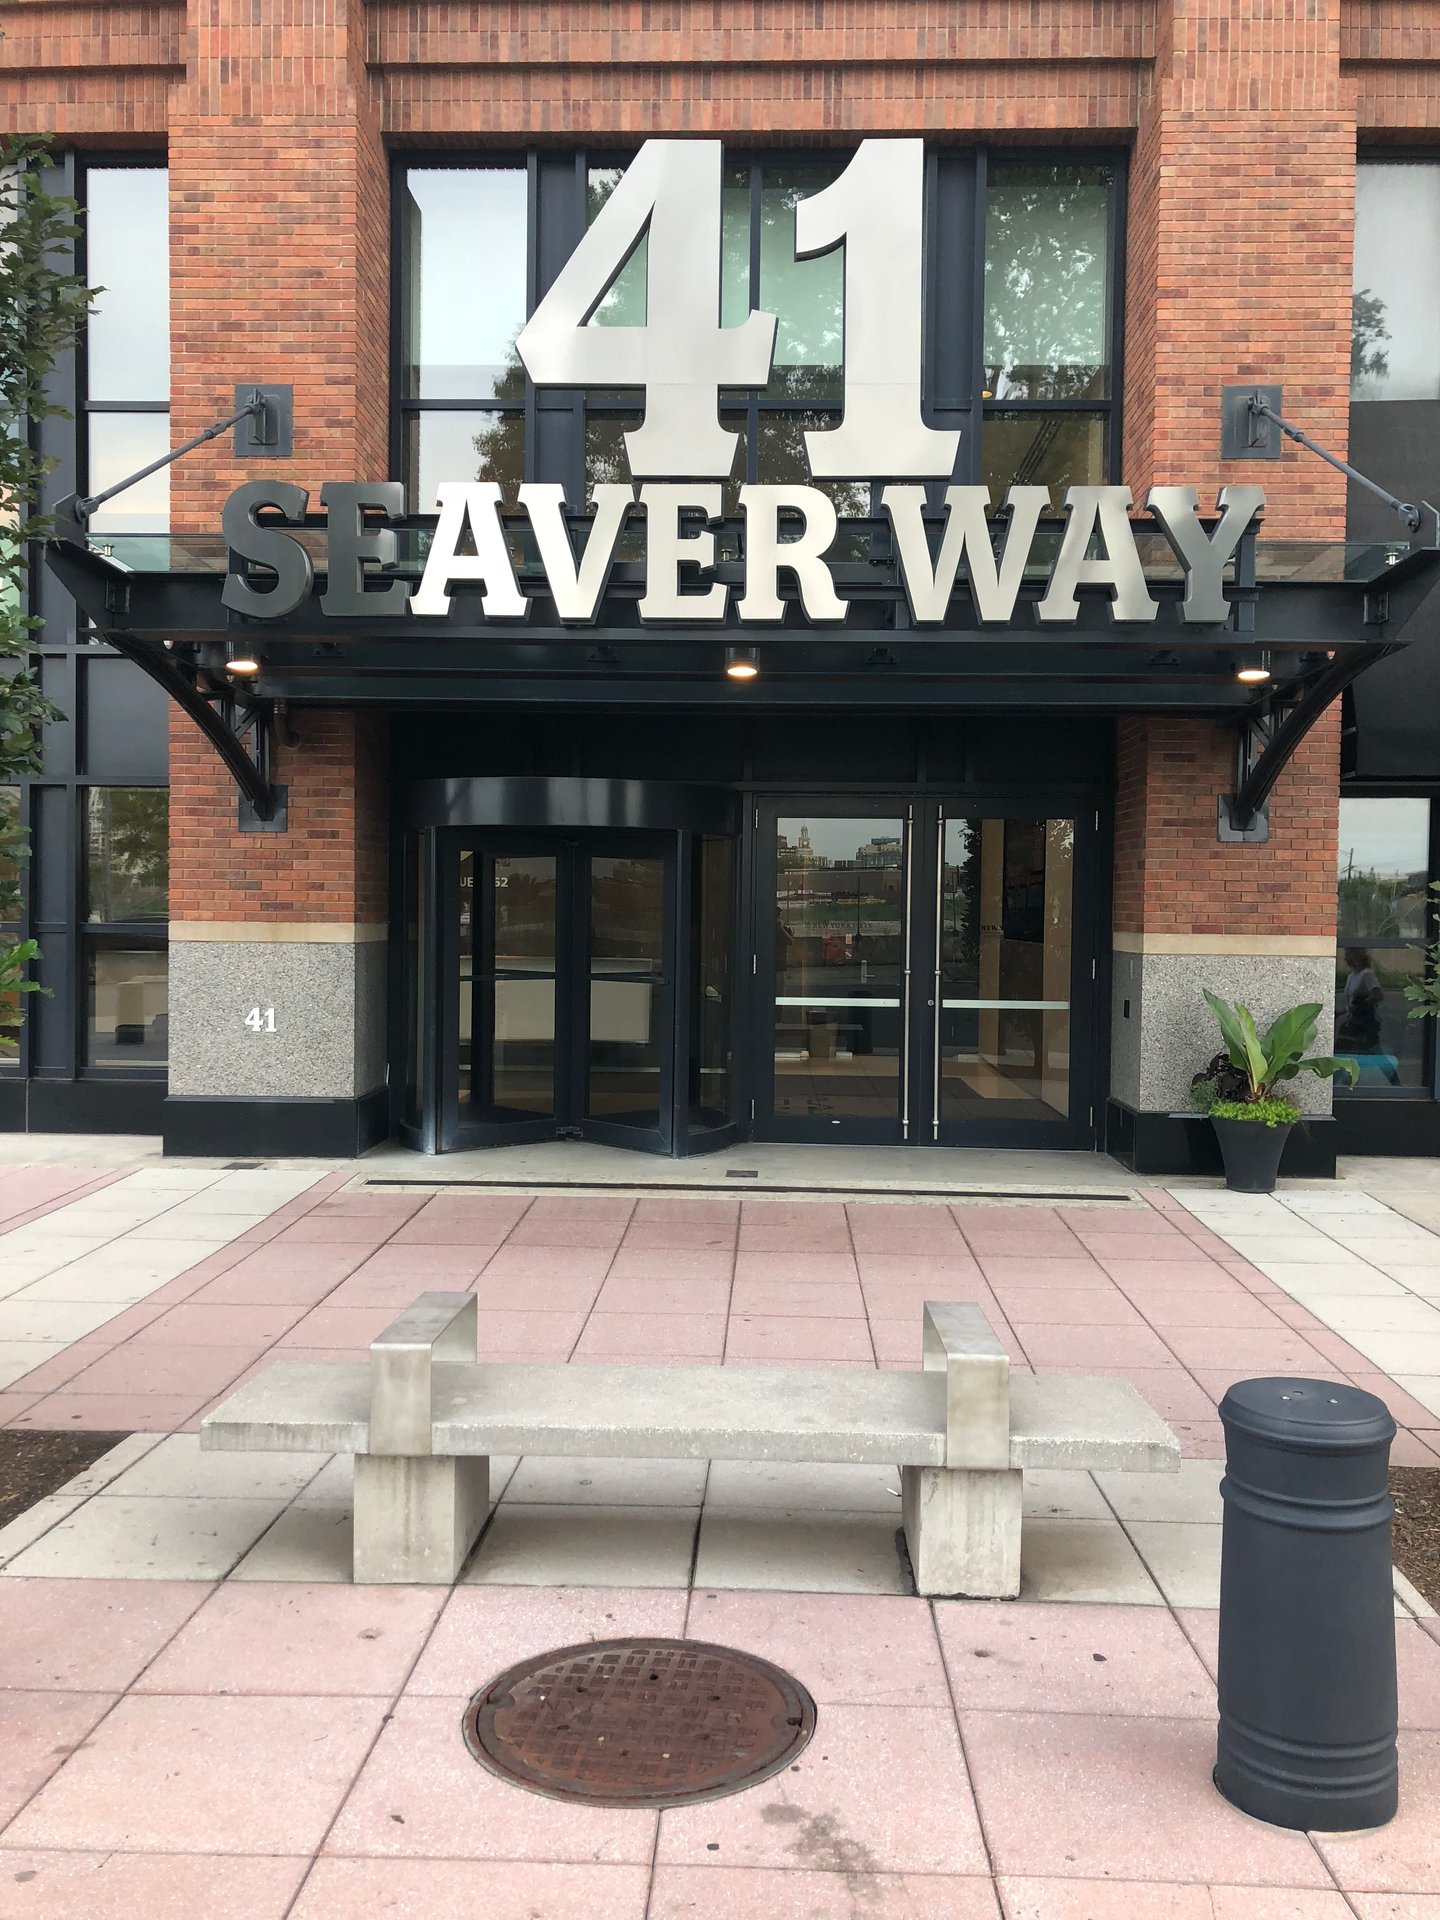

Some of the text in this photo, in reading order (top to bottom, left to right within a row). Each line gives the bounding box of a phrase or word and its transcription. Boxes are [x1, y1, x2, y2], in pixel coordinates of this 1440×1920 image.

[516, 137, 964, 480] 41
[221, 480, 1266, 626] SEAVER WAY
[244, 1007, 278, 1033] 41
